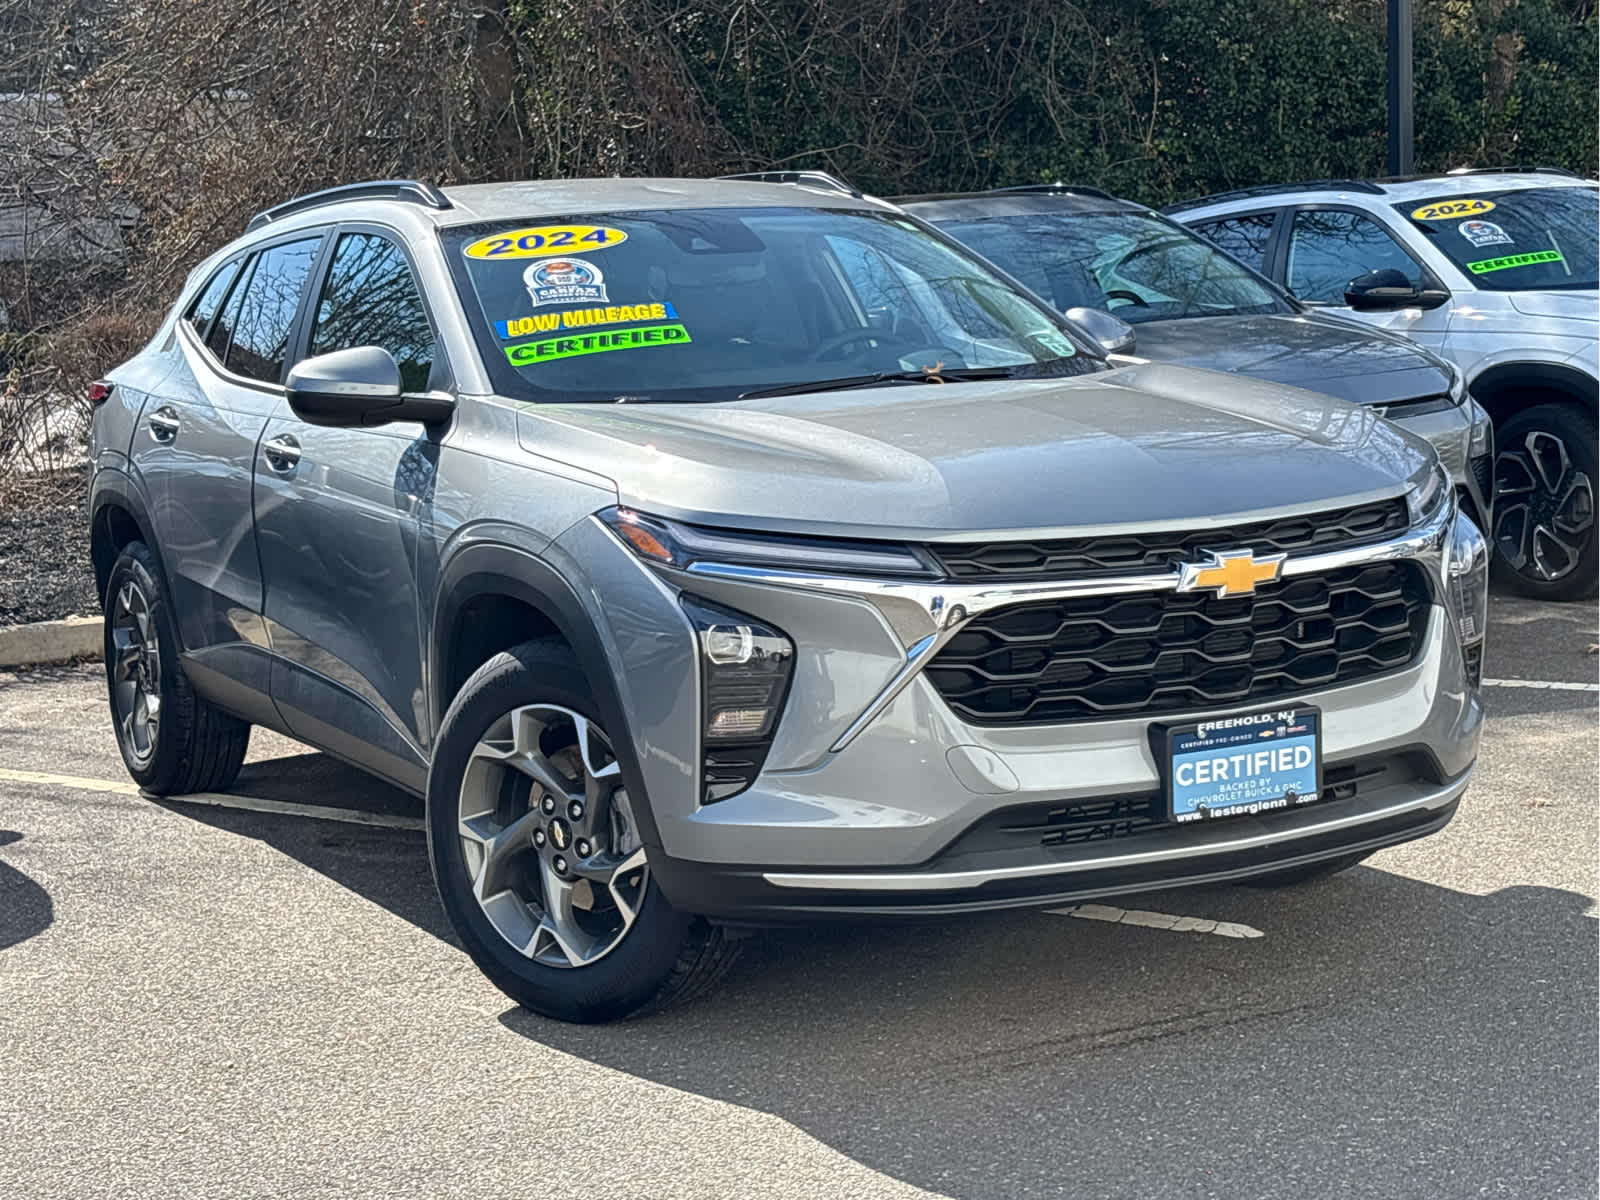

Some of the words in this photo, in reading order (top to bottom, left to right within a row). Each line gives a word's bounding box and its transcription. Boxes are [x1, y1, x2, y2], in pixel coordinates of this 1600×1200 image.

[1422, 201, 1488, 218] 2024
[486, 229, 609, 256] 2024
[1471, 252, 1558, 271] CERTIFIED
[506, 313, 561, 337] LOW
[563, 303, 667, 328] MILEAGE
[511, 327, 685, 361] CERTIFIED
[1198, 714, 1274, 731] FREEHOLD,
[1176, 745, 1312, 786] CERTIFIED
[1187, 790, 1242, 807] CHEVROLET
[1245, 787, 1273, 800] BUICK
[1274, 785, 1280, 793] &
[1282, 781, 1303, 792] GMC
[1219, 780, 1257, 793] BACKED
[1259, 777, 1271, 787] BY
